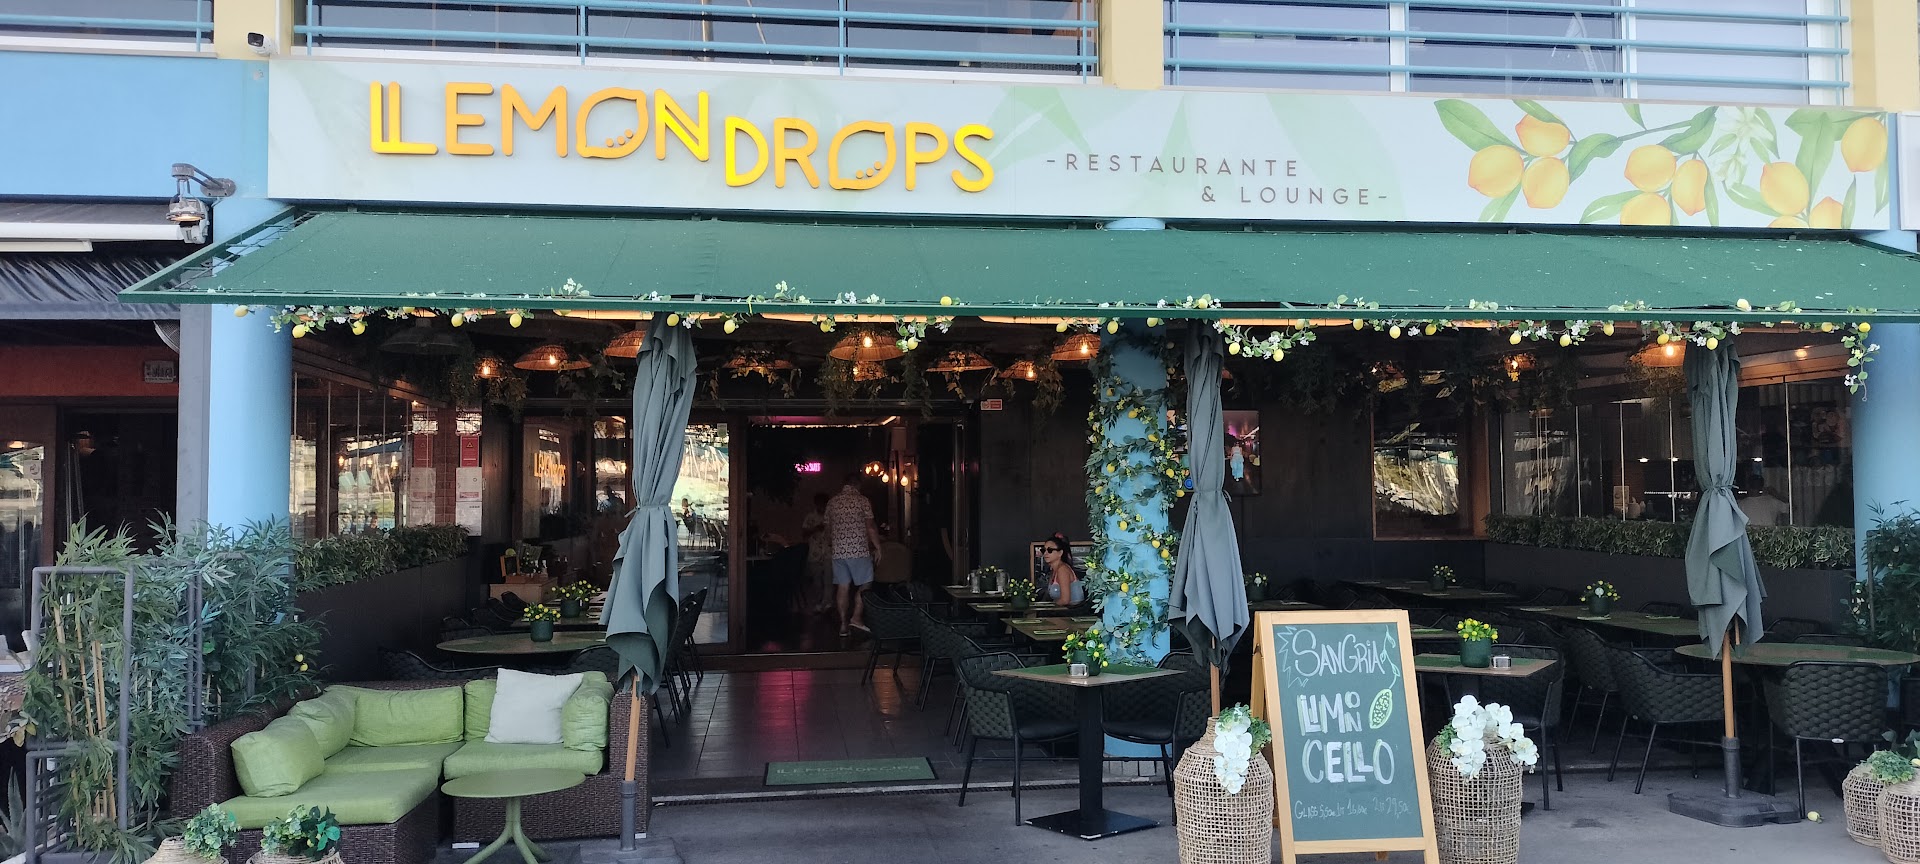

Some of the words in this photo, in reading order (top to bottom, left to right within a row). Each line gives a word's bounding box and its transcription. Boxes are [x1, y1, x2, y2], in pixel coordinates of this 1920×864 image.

[724, 115, 994, 193] DROPS
[1201, 186, 1216, 203] &
[1302, 739, 1395, 784] CELLO
